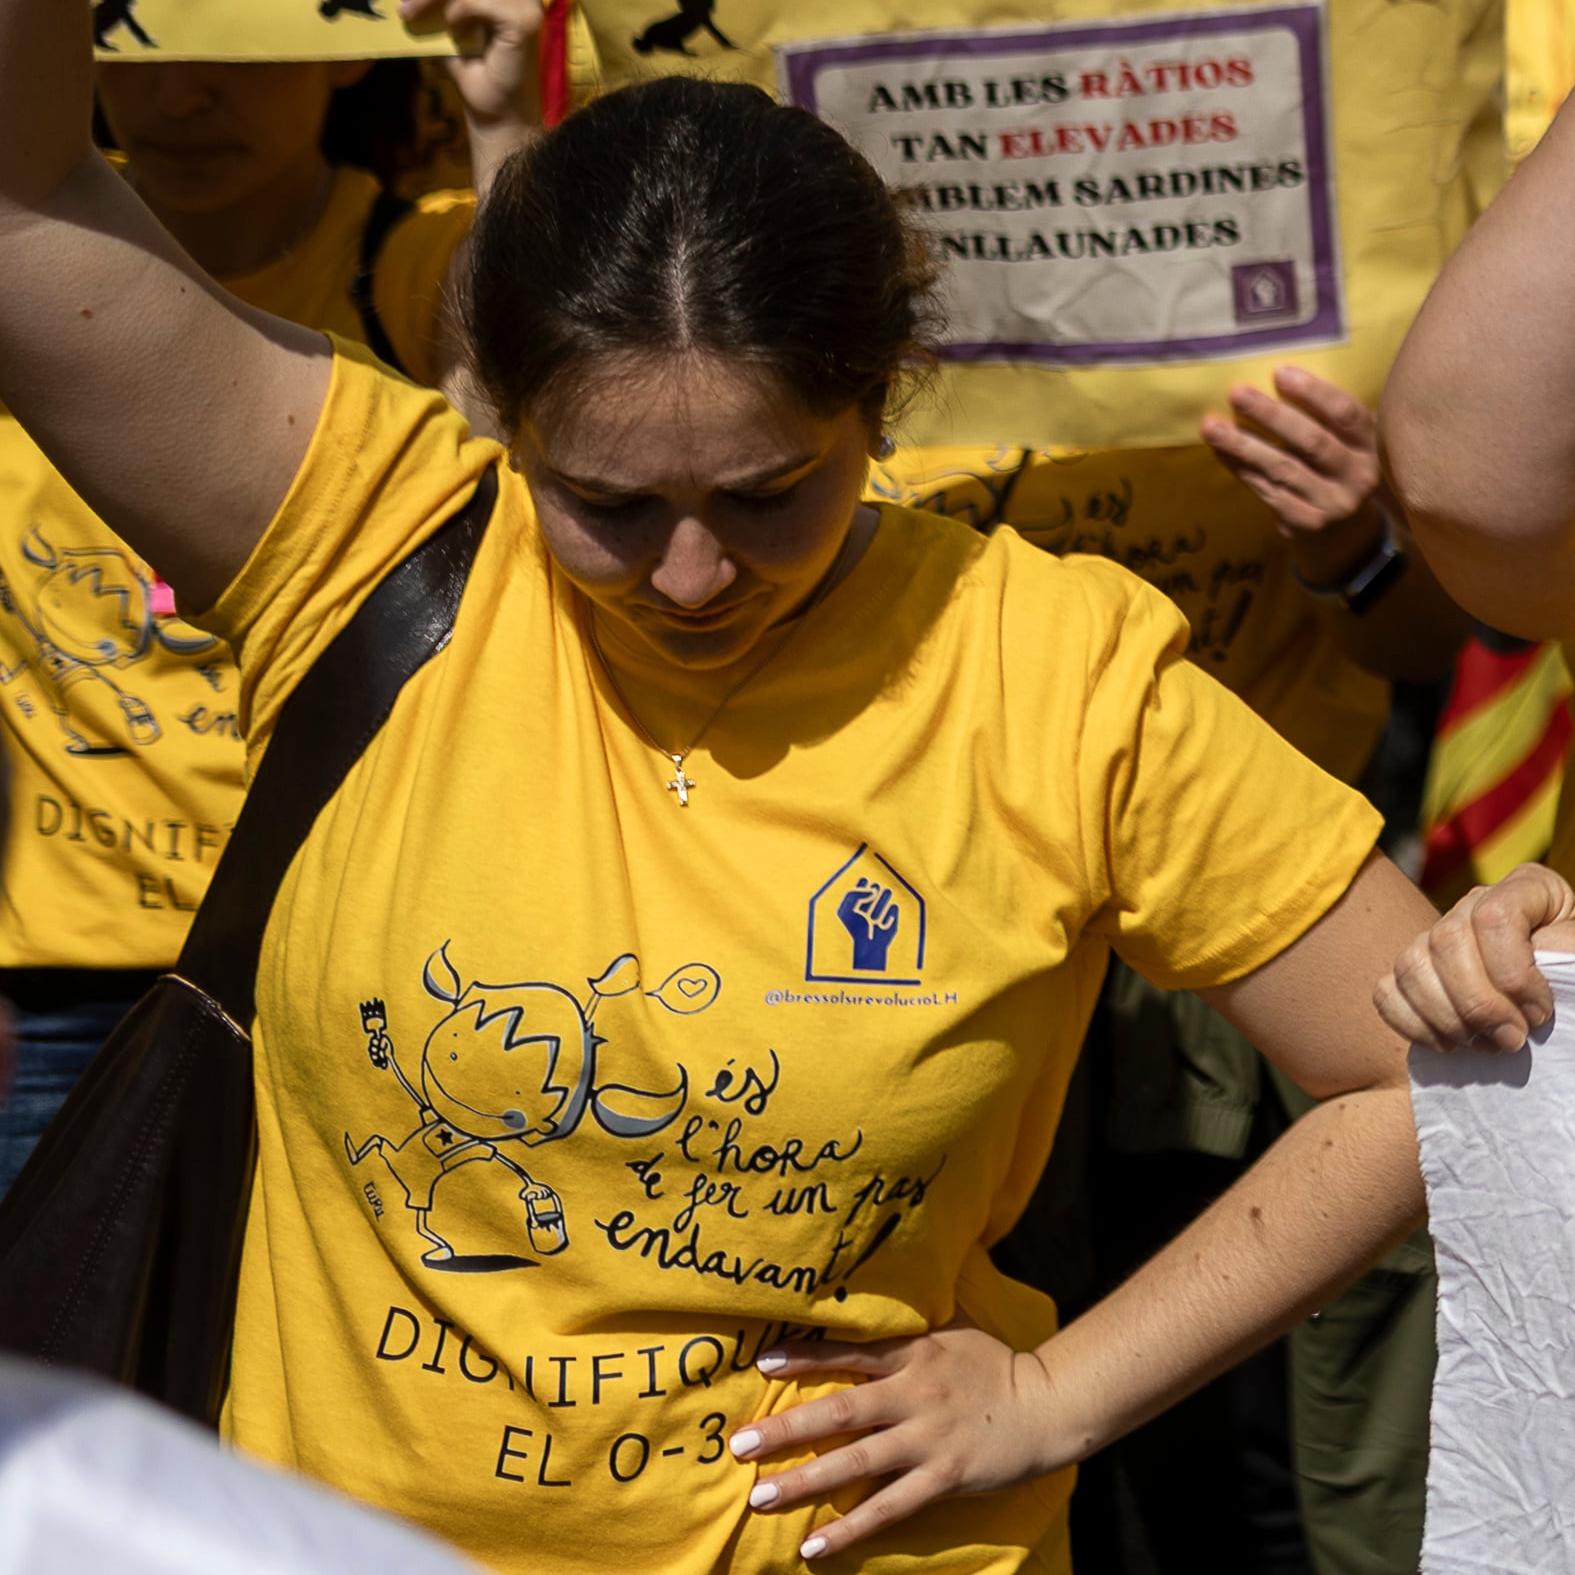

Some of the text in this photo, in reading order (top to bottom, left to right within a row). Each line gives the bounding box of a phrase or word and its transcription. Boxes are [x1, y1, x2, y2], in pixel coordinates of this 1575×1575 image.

[866, 56, 1255, 116] AMB LES RÀTIOS
[890, 111, 1238, 165] TAN ELEVADES
[1071, 159, 1305, 211] SARDINES
[940, 218, 1242, 264] NLLAUNADES
[35, 794, 235, 864] DIGNIF
[706, 1048, 781, 1116] és
[625, 1152, 948, 1230] de fer un pas
[594, 1209, 903, 1304] endavant!
[494, 1424, 573, 1487] EL
